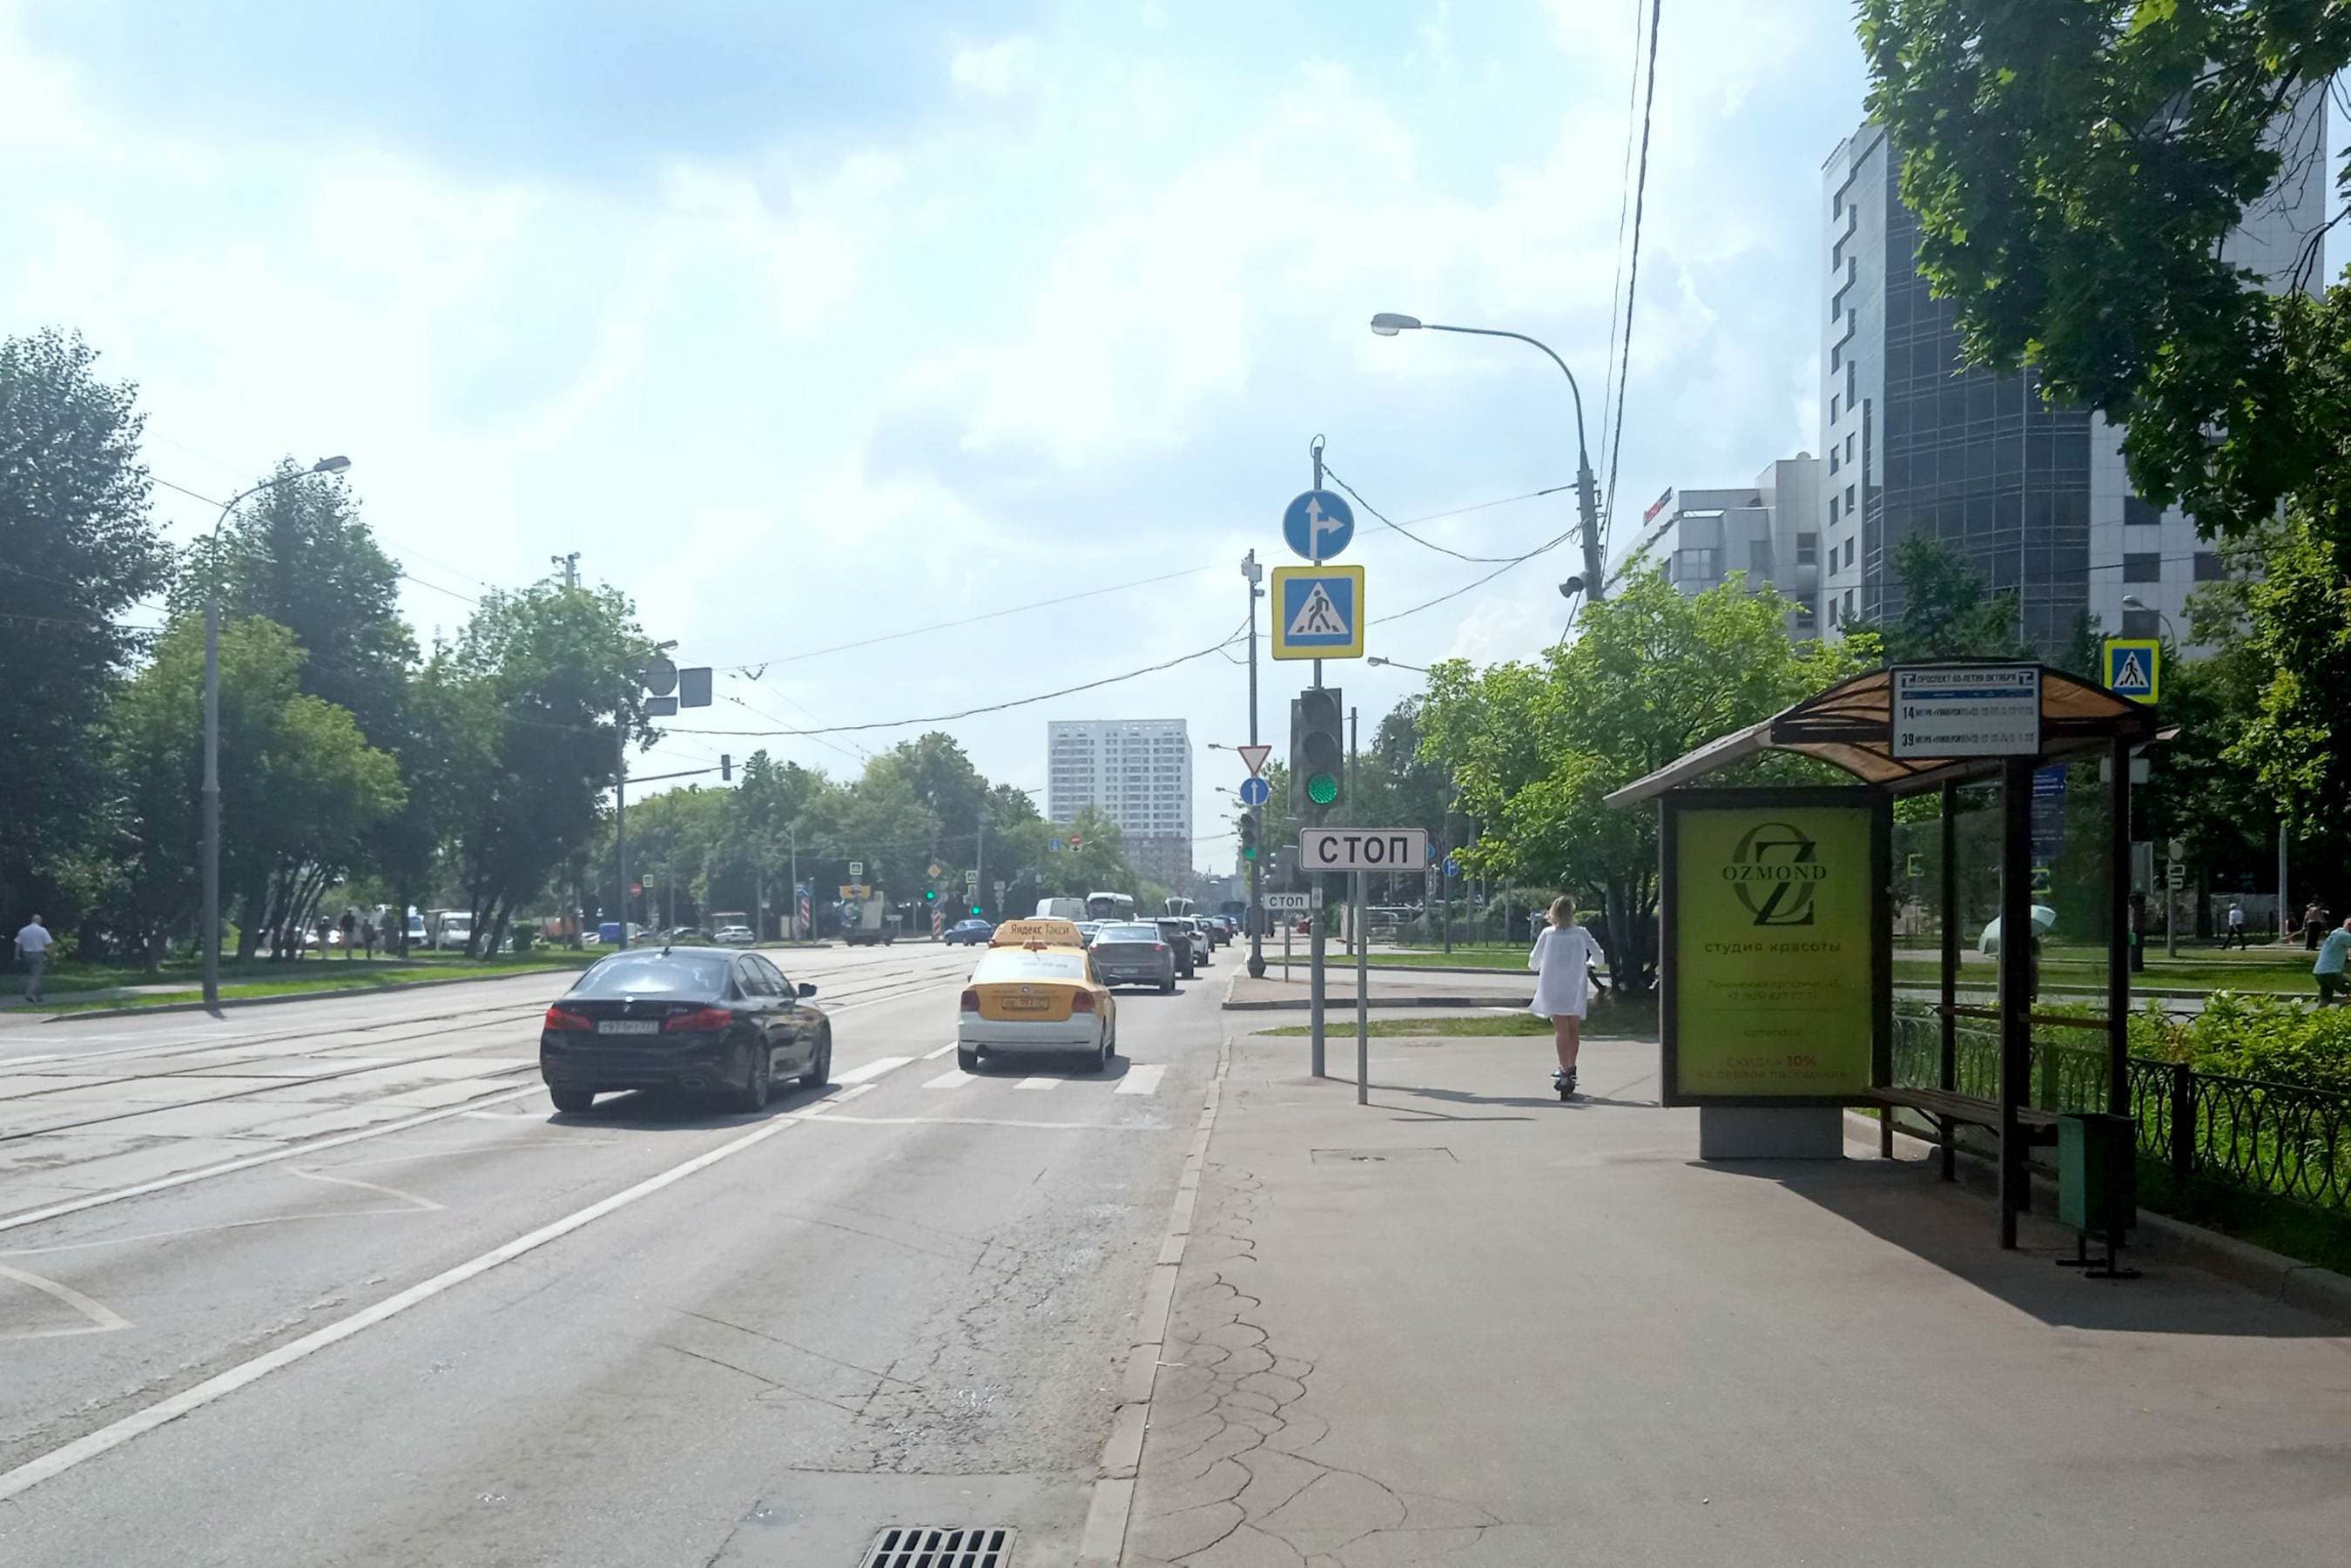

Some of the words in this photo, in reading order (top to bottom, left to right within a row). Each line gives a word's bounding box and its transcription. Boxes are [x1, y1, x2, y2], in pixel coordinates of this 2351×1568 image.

[1903, 706, 1915, 719] 14
[1903, 733, 1914, 746] 39
[1318, 836, 1408, 864] СТОП
[1722, 865, 1827, 880] OZMOND
[1269, 896, 1303, 907] СТОП
[1011, 924, 1042, 936] Яндекс
[1045, 923, 1070, 935] Такси
[1705, 942, 1762, 954] студия
[1770, 941, 1842, 954] красоты
[1787, 1055, 1817, 1067] 10%
